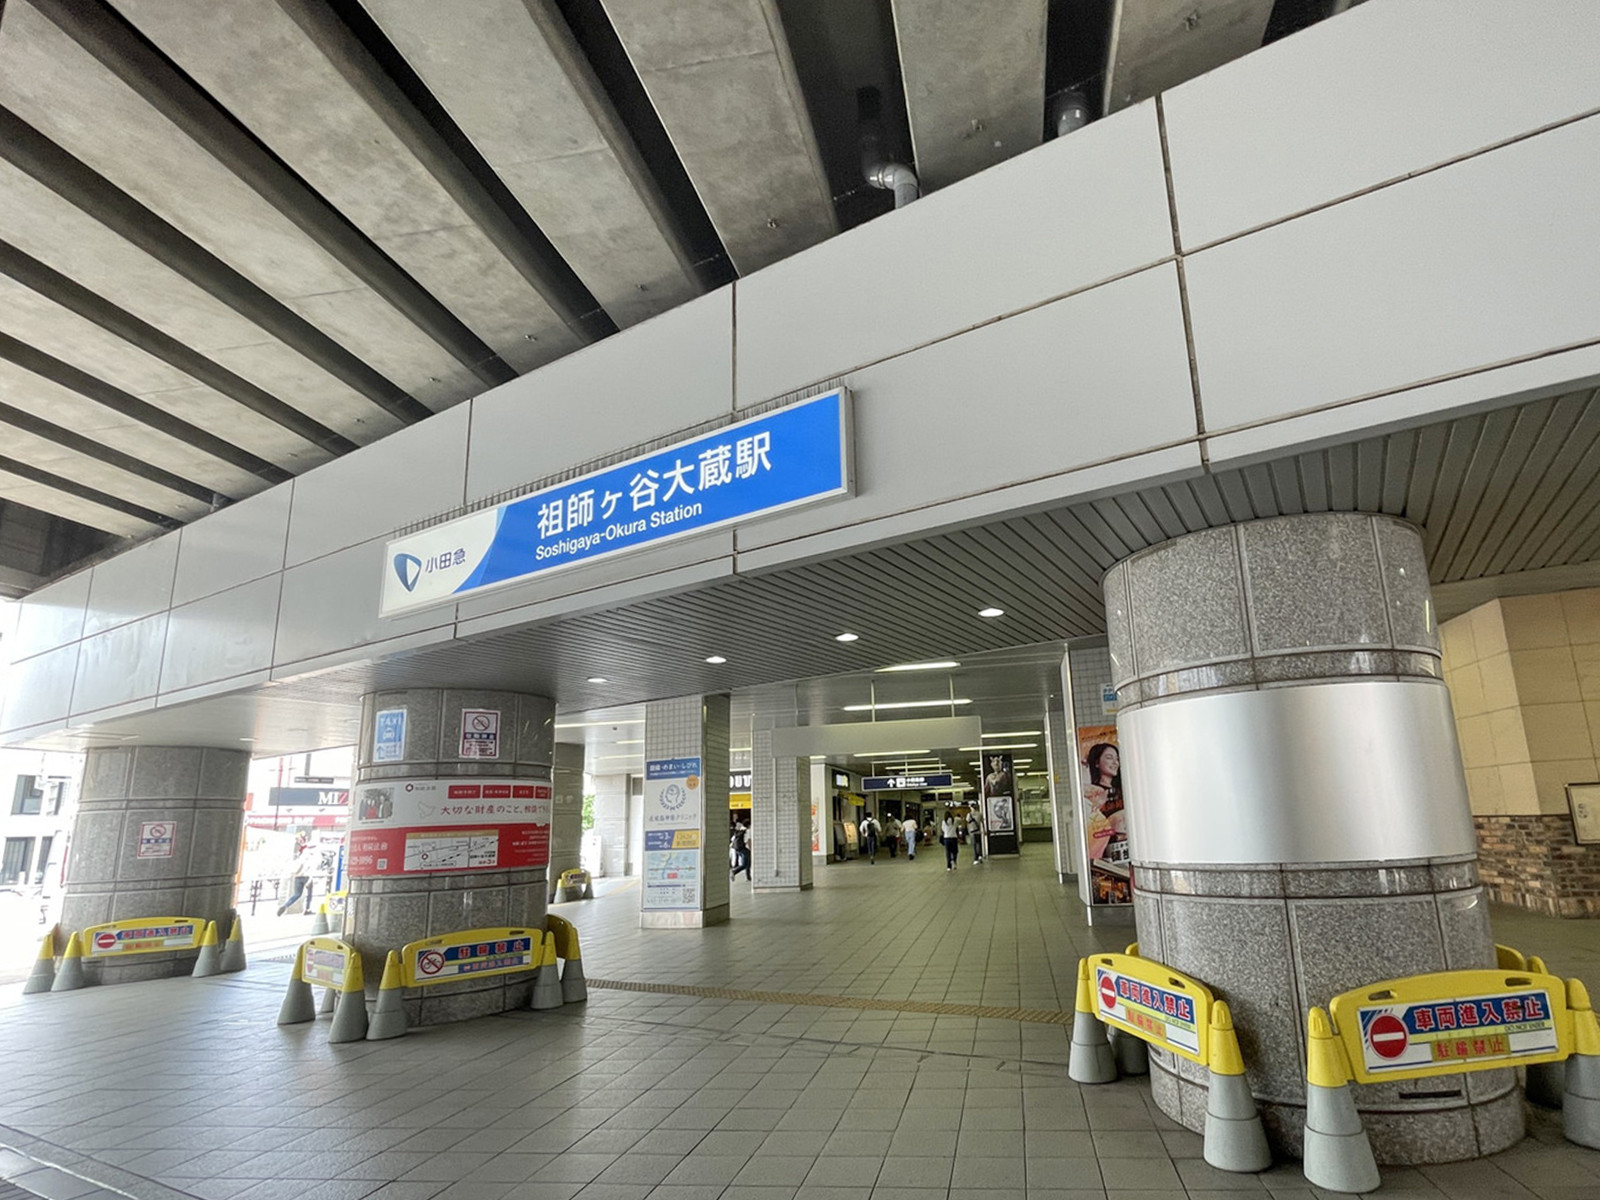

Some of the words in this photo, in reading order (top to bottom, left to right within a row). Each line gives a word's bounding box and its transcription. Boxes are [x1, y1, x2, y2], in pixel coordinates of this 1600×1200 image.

[537, 431, 773, 539] 祖師ヶ谷大蔵駅
[535, 516, 648, 562] Soshigaya-Okura
[649, 501, 703, 529] Station
[424, 548, 467, 573] 小田急
[1119, 979, 1192, 1021] 車両進入禁止
[1413, 995, 1544, 1032] 車両進入禁止
[1435, 1038, 1506, 1060] 駐輪禁止
